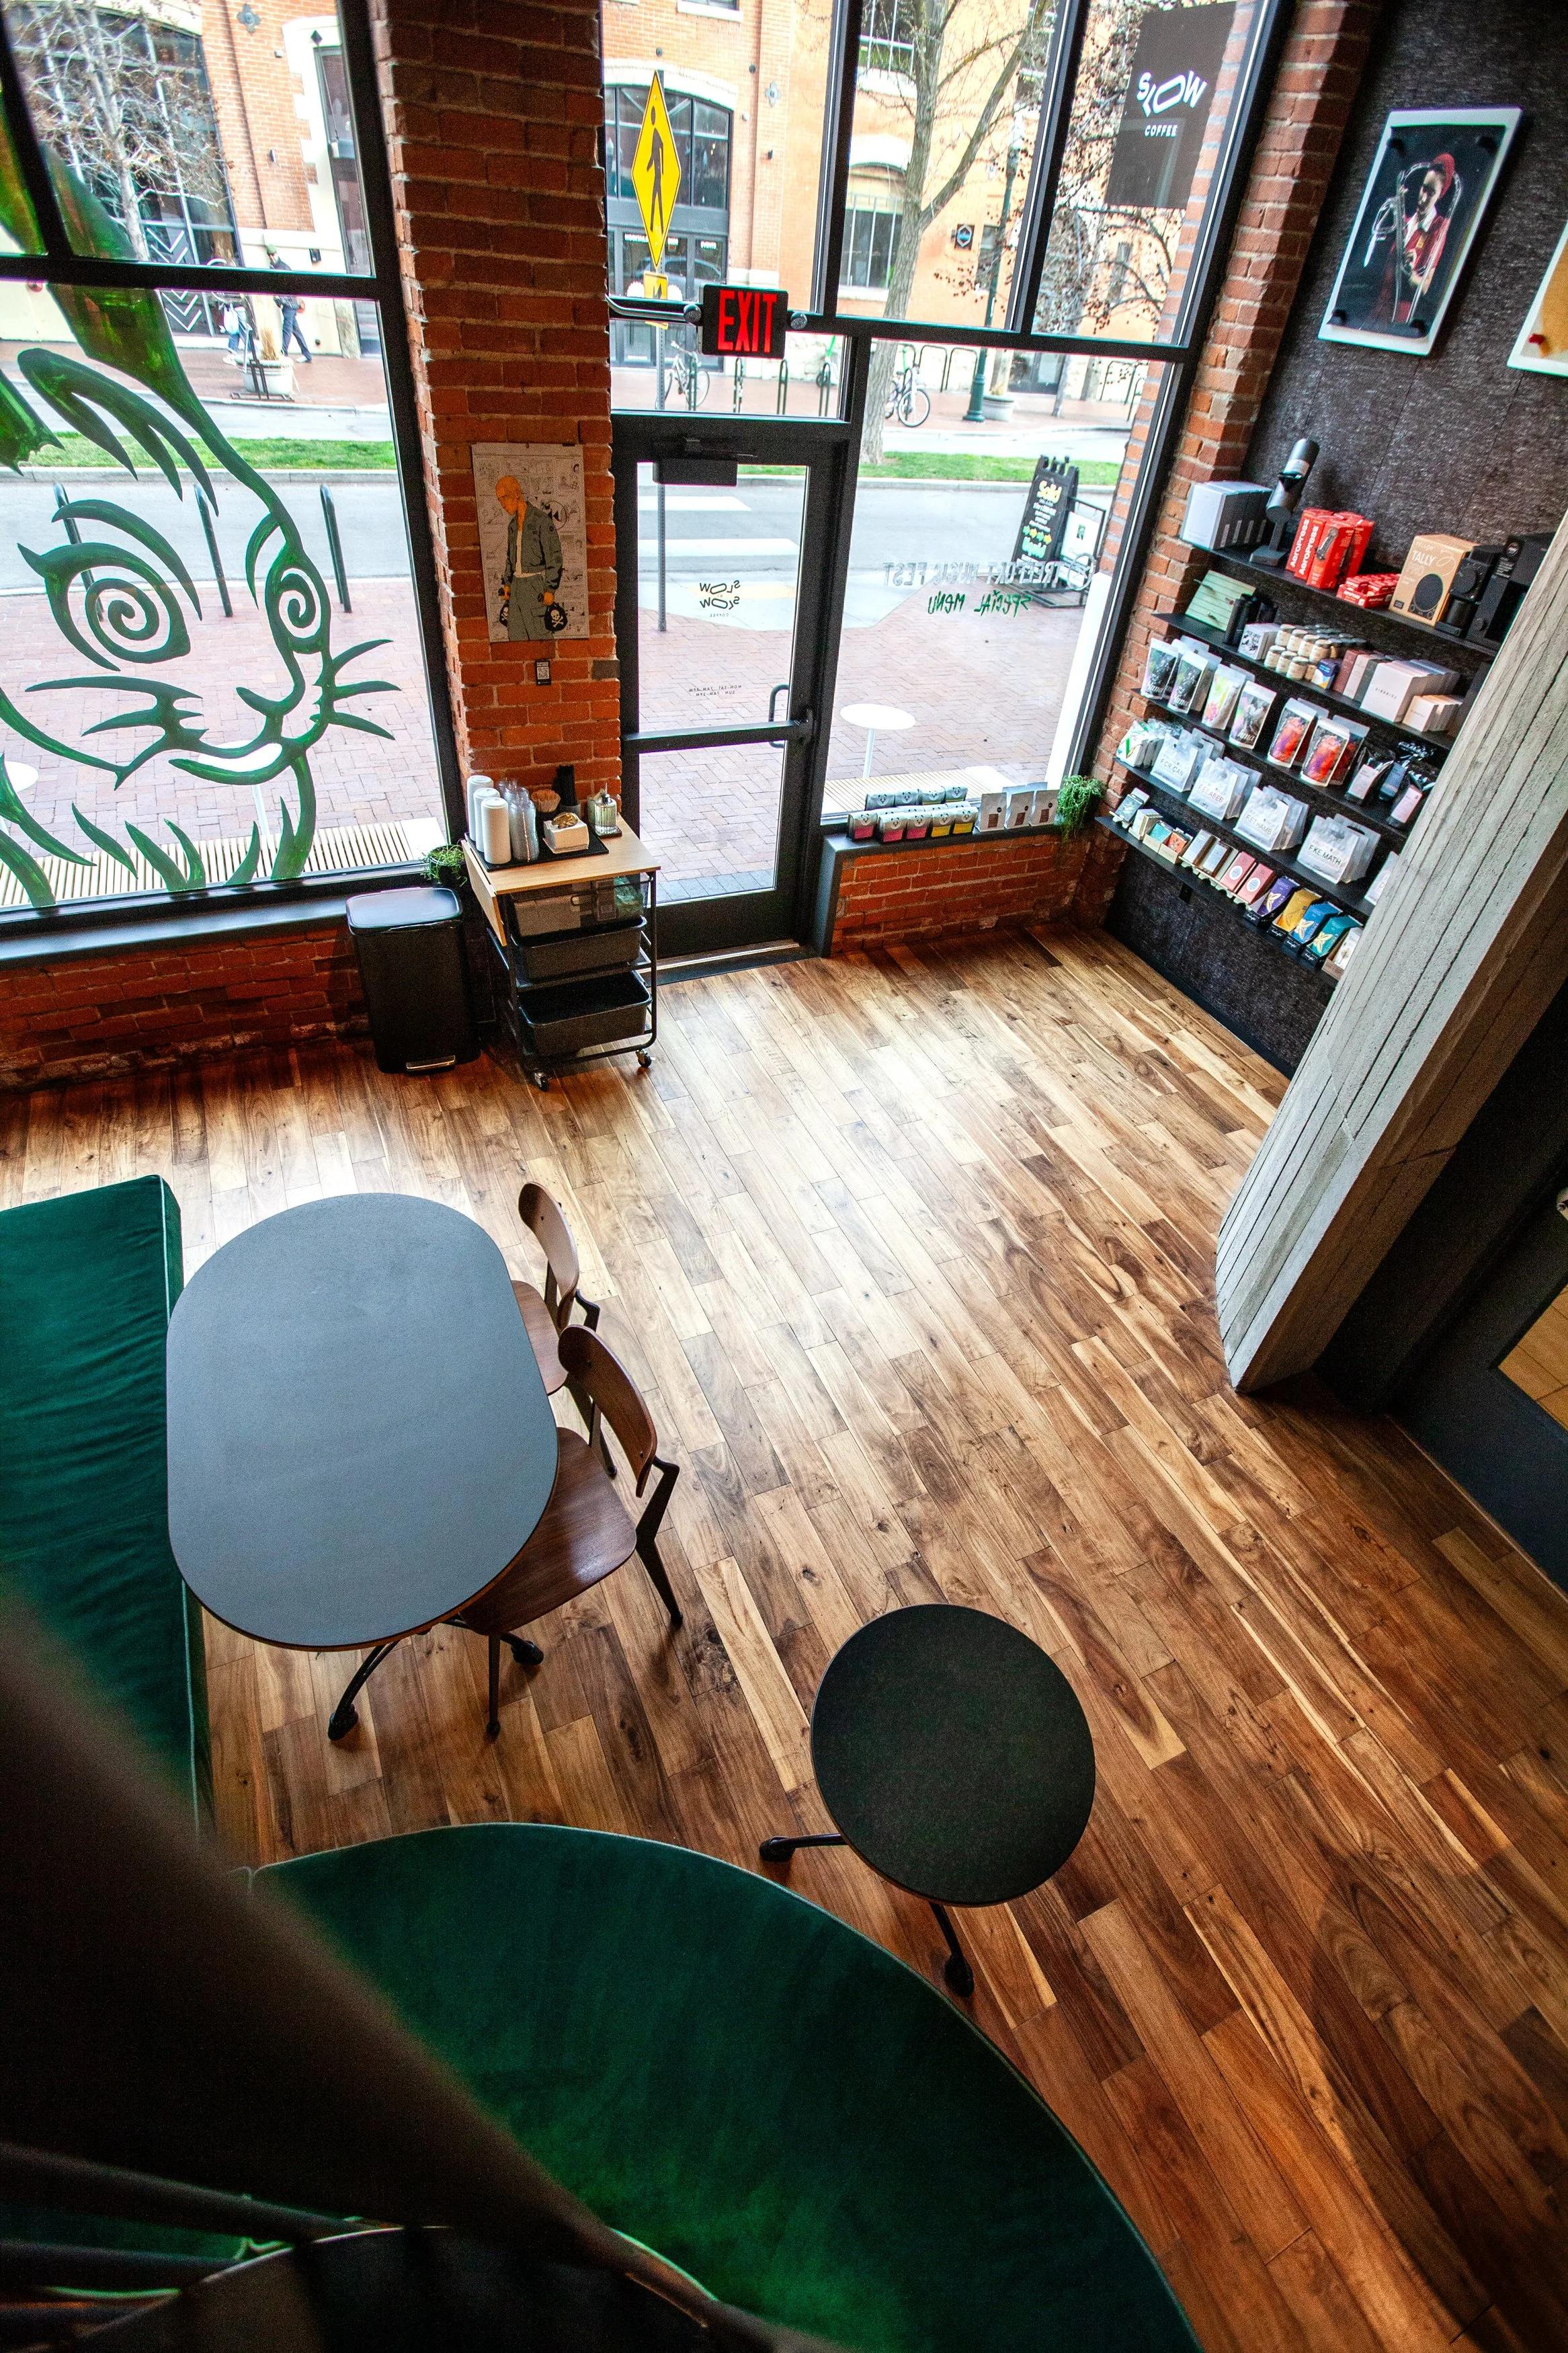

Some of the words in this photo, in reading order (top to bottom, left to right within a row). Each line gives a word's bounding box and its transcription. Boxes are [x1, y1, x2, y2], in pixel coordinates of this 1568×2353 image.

[1136, 70, 1208, 117] SLOW
[1145, 124, 1178, 136] COFFEE
[718, 290, 778, 353] EXIT
[1411, 551, 1436, 566] TALLY
[1309, 844, 1342, 866] F.KE.MATH
